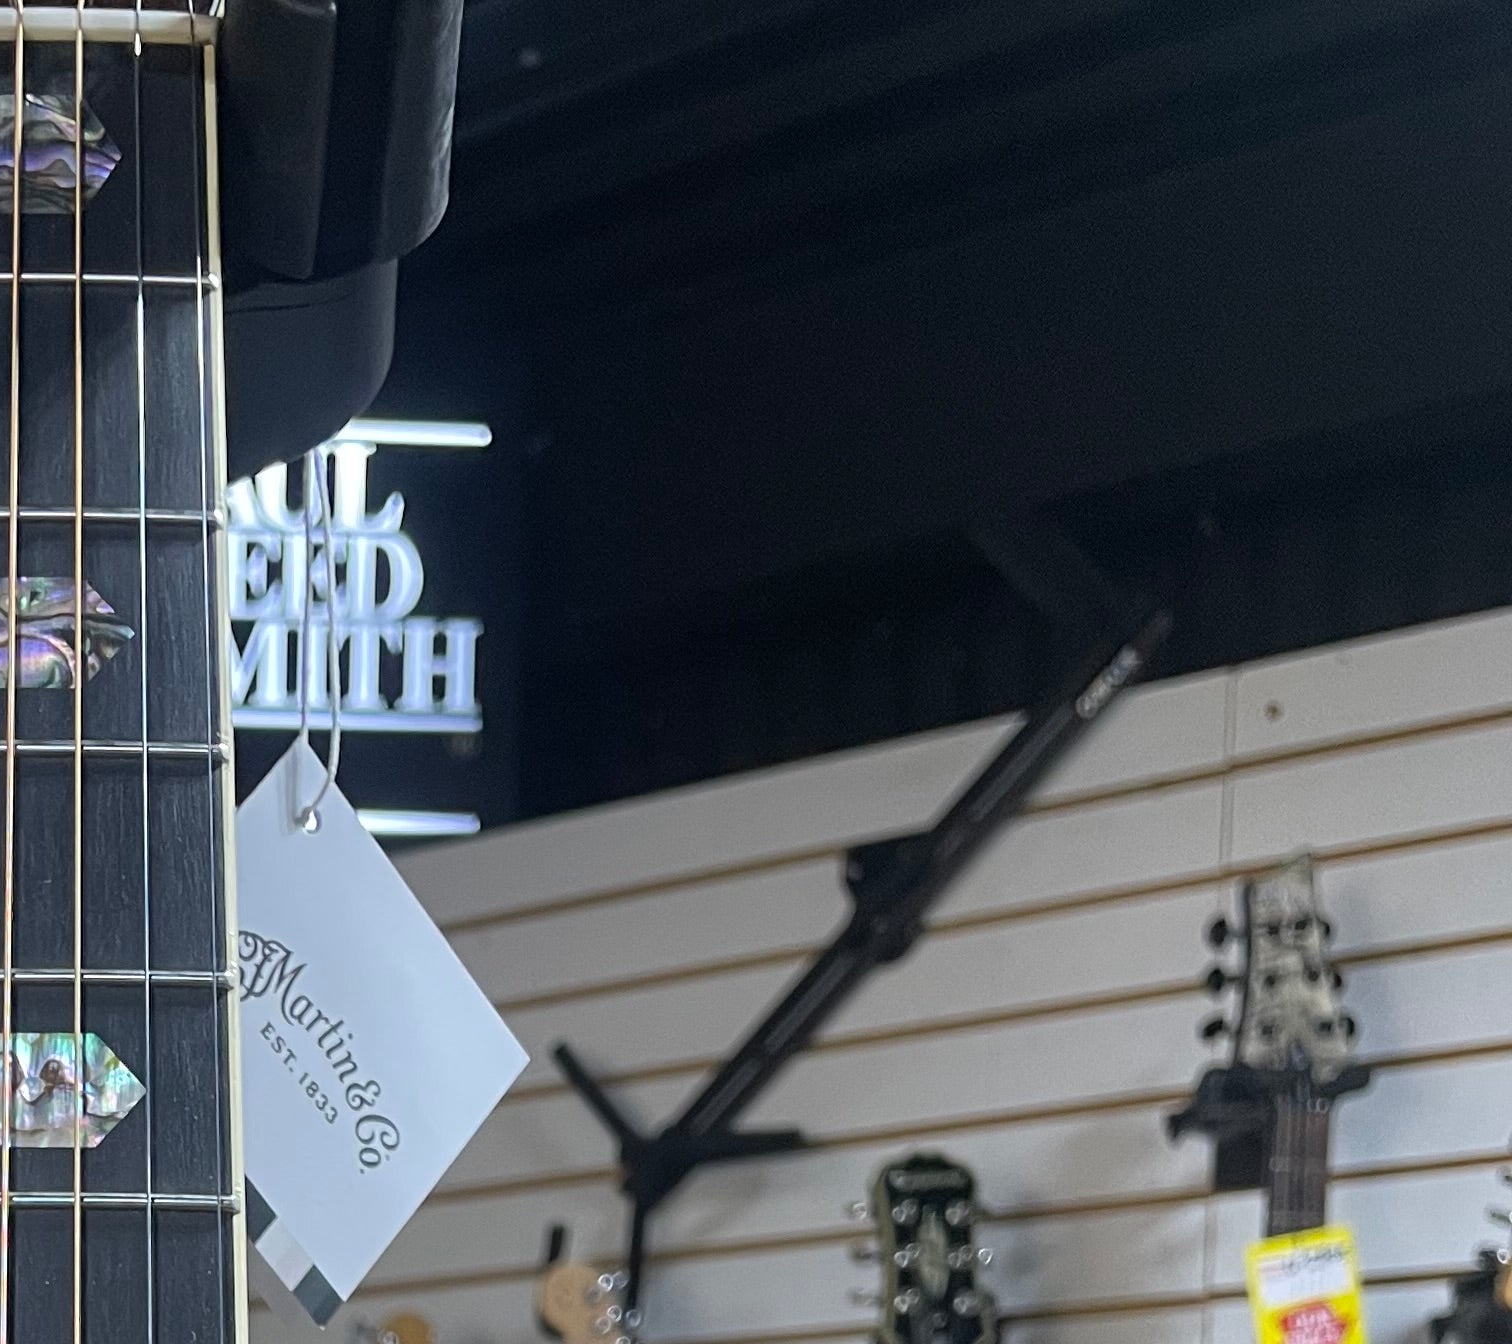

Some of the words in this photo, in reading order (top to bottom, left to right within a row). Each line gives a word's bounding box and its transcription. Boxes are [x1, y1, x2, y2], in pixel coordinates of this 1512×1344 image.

[228, 529, 425, 622] EED
[230, 616, 485, 713] MITH
[259, 1020, 298, 1074] EST.
[297, 1070, 339, 1126] 1833
